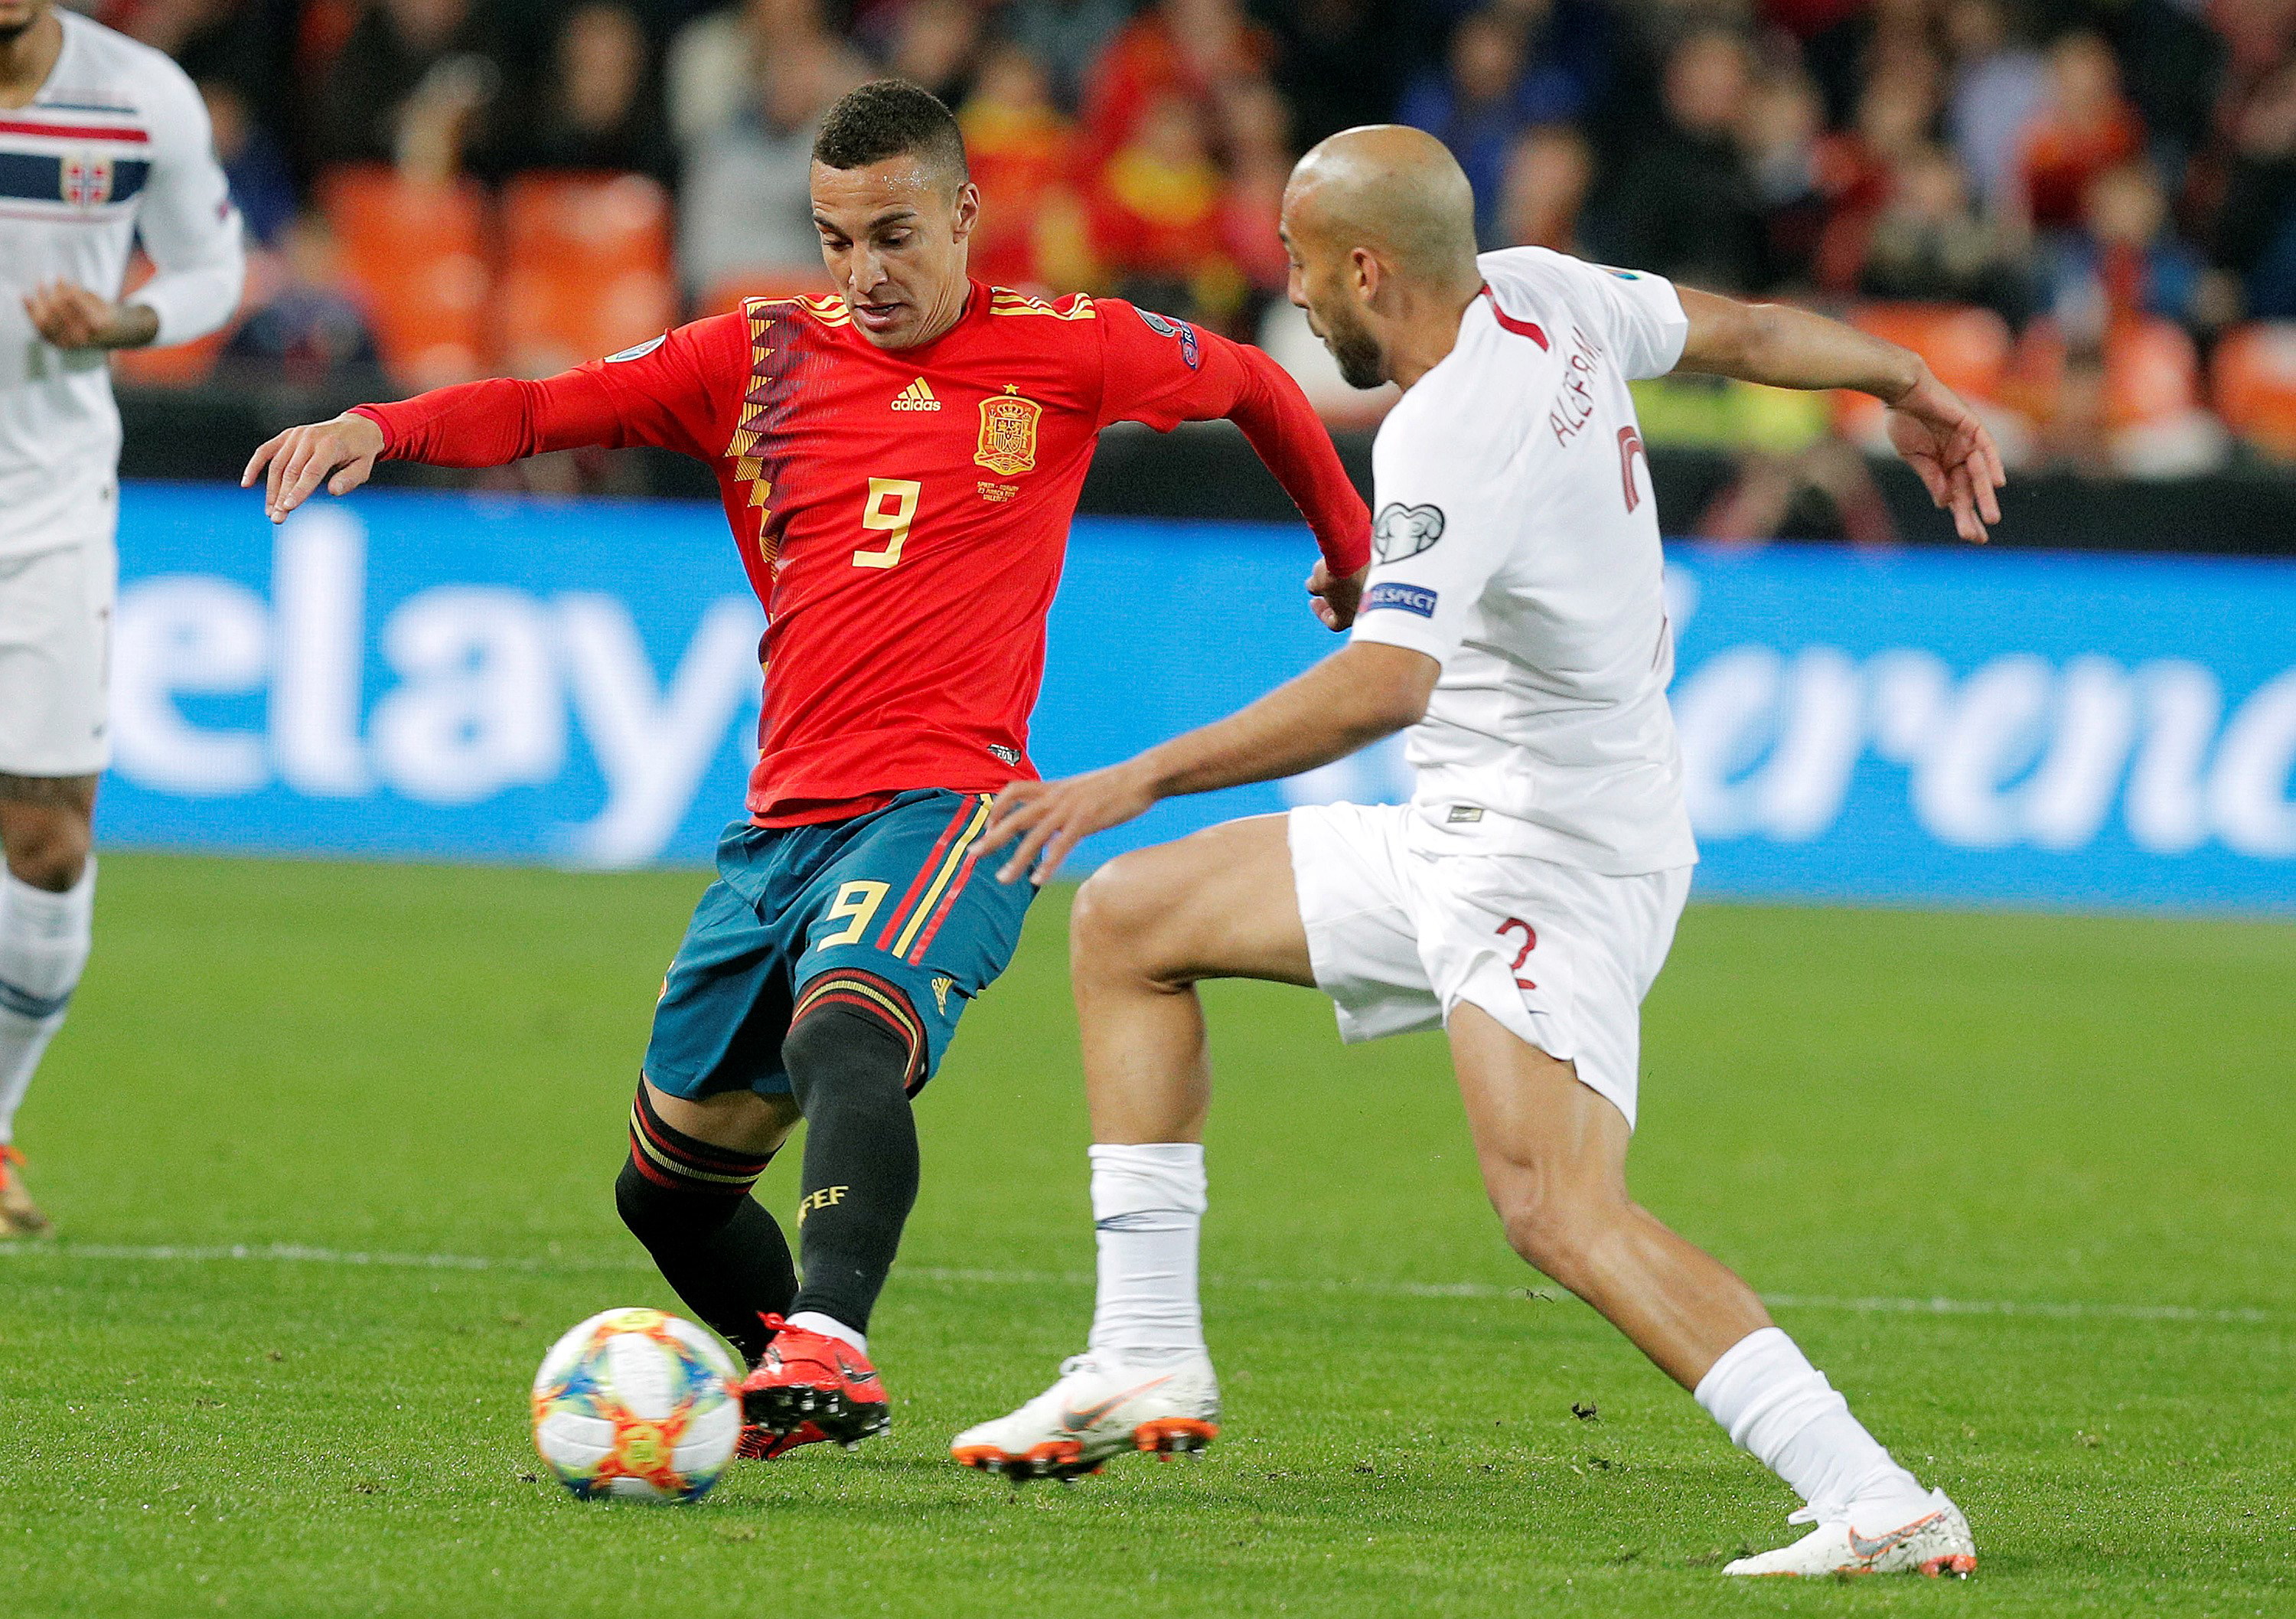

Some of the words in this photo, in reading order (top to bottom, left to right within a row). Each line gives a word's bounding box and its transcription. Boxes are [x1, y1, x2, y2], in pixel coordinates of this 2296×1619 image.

[891, 397, 941, 411] adidas
[852, 477, 922, 569] 9
[816, 880, 892, 952] 9
[1495, 916, 1538, 990] 2
